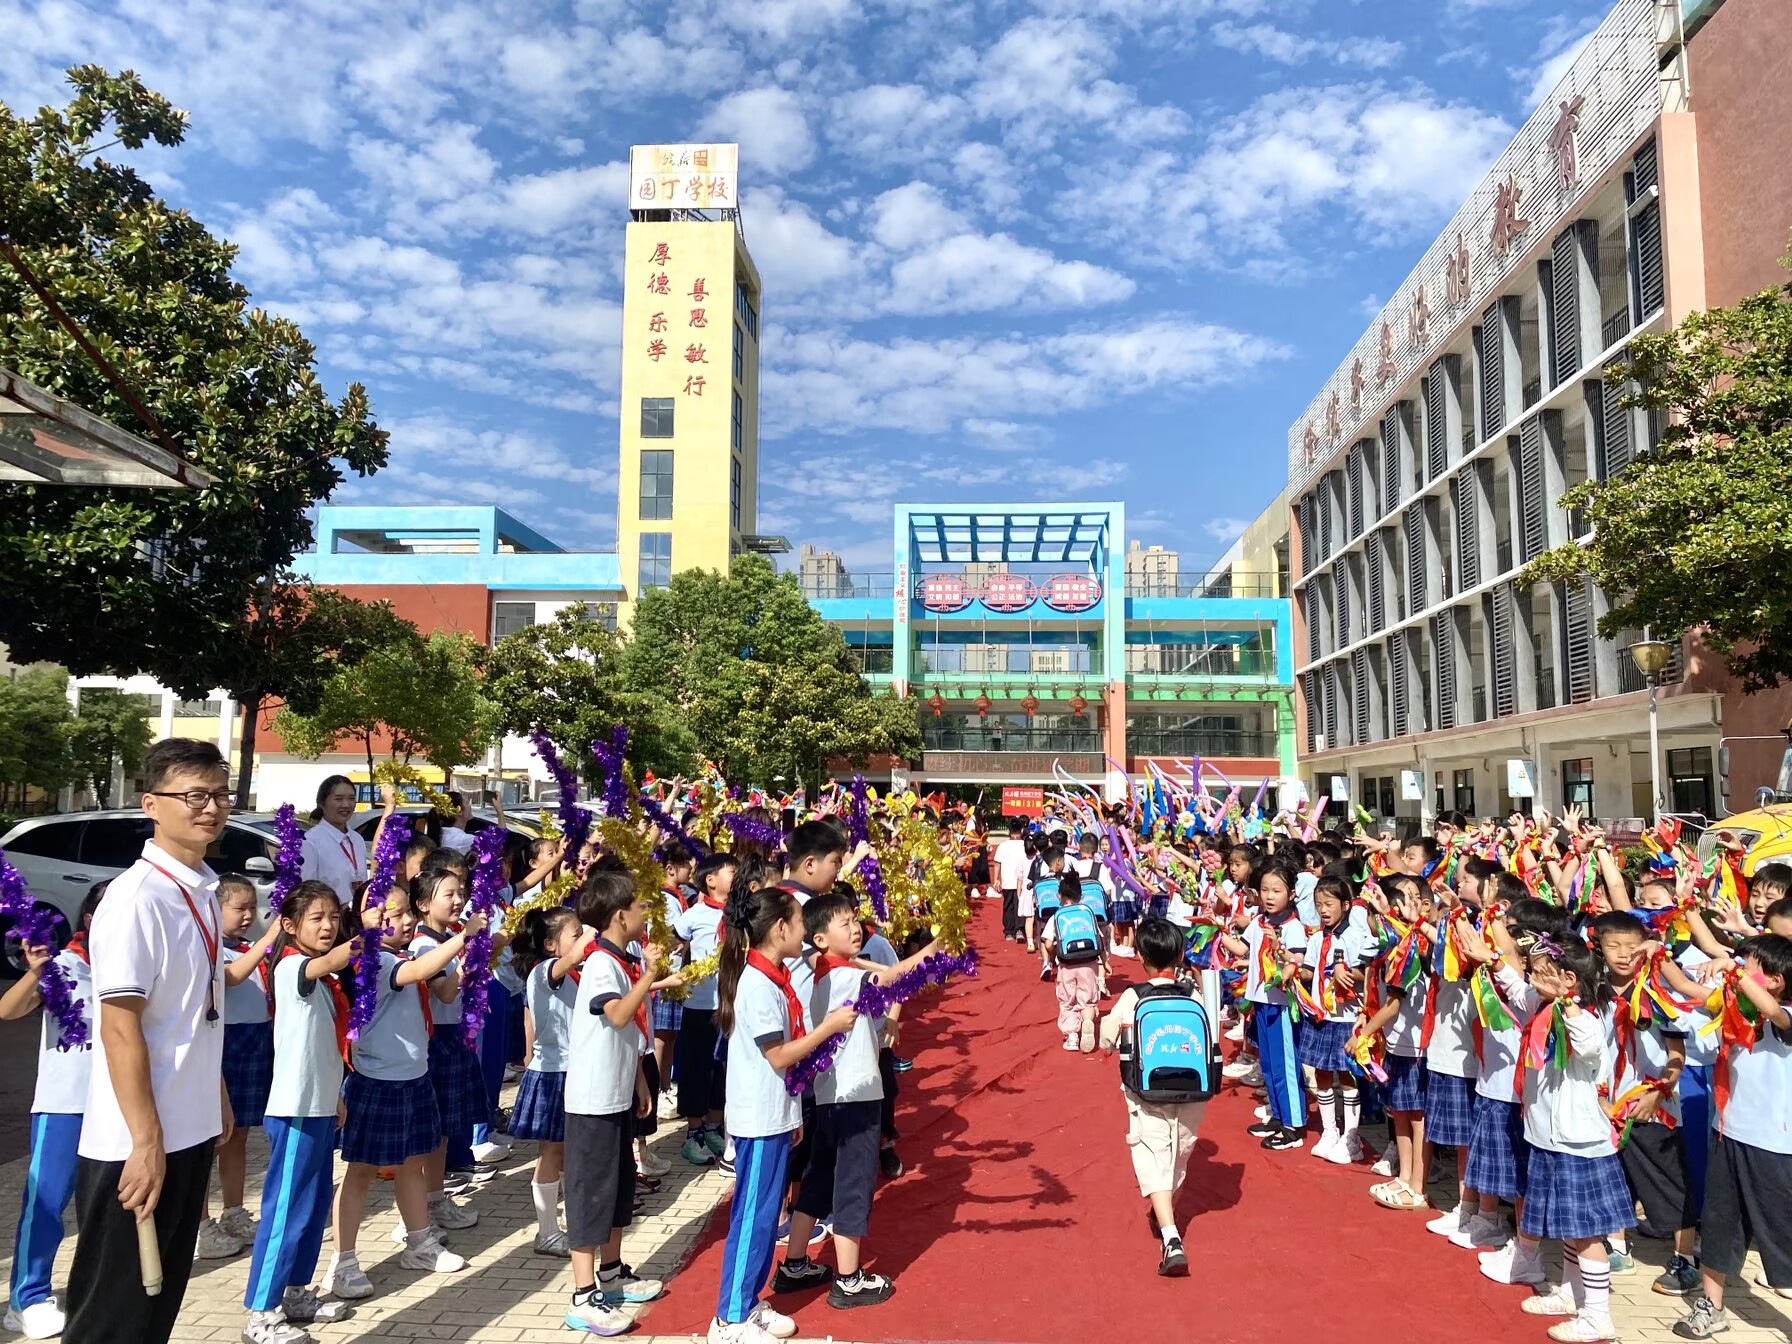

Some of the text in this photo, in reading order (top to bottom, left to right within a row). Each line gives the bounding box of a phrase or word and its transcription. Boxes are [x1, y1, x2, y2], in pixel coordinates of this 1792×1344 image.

[639, 175, 729, 202] 园丁学校
[646, 242, 672, 363] 厚德乐学
[682, 277, 710, 397] 善思敏行
